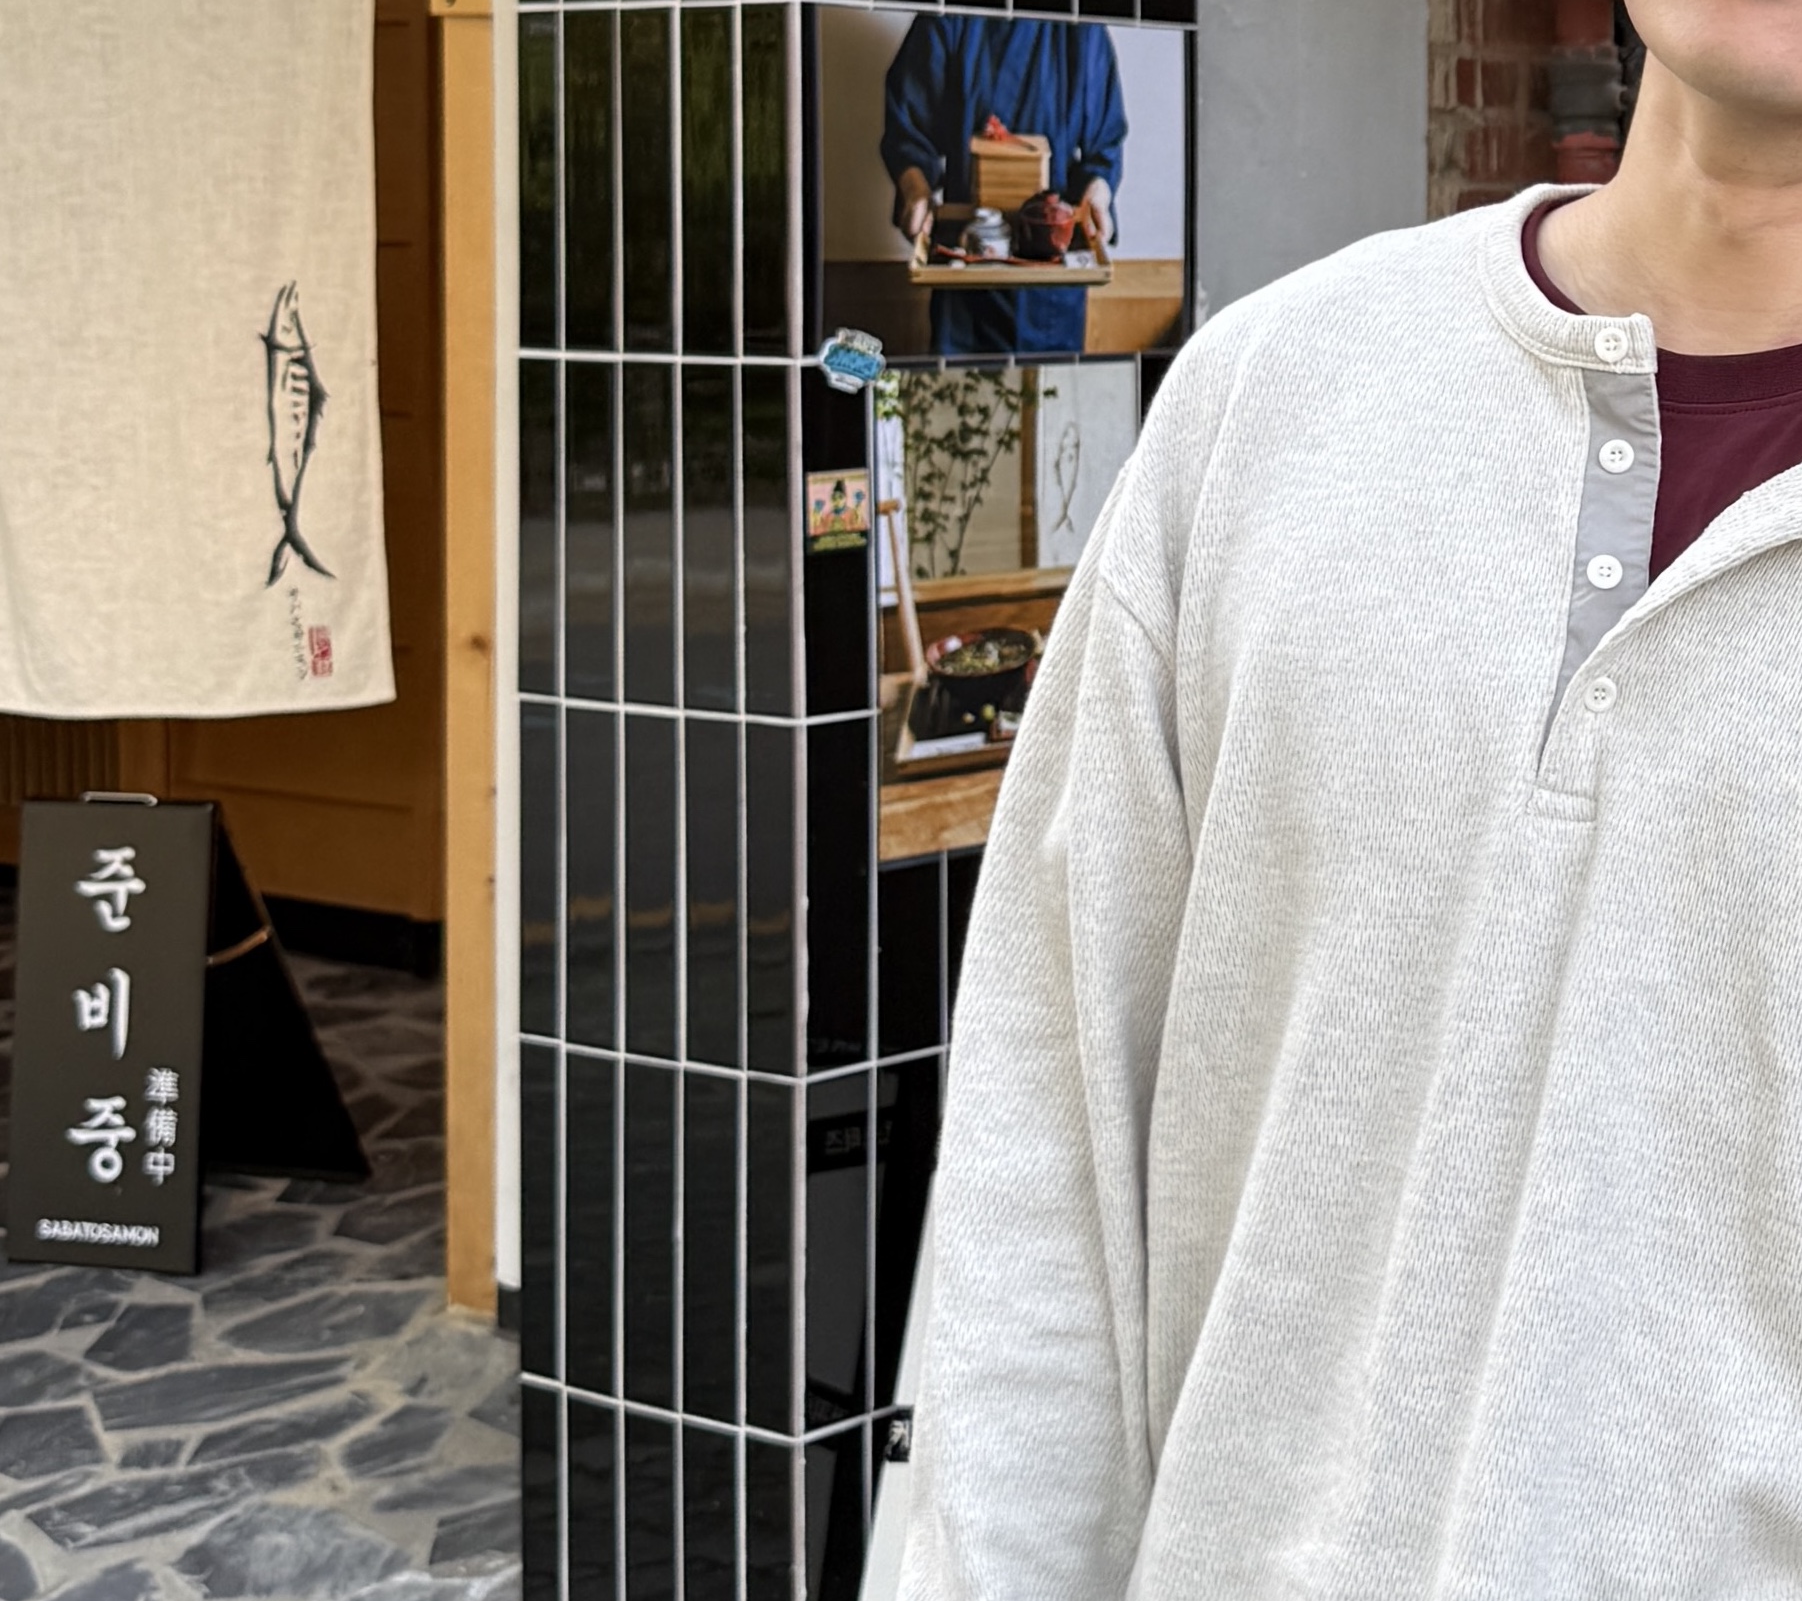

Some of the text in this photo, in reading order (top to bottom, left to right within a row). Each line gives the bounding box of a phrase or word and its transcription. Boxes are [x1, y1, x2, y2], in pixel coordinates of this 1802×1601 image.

[65, 845, 147, 1185] 준비중
[142, 1066, 180, 1187] 準備中
[36, 1217, 160, 1247] SABATOSAMON
